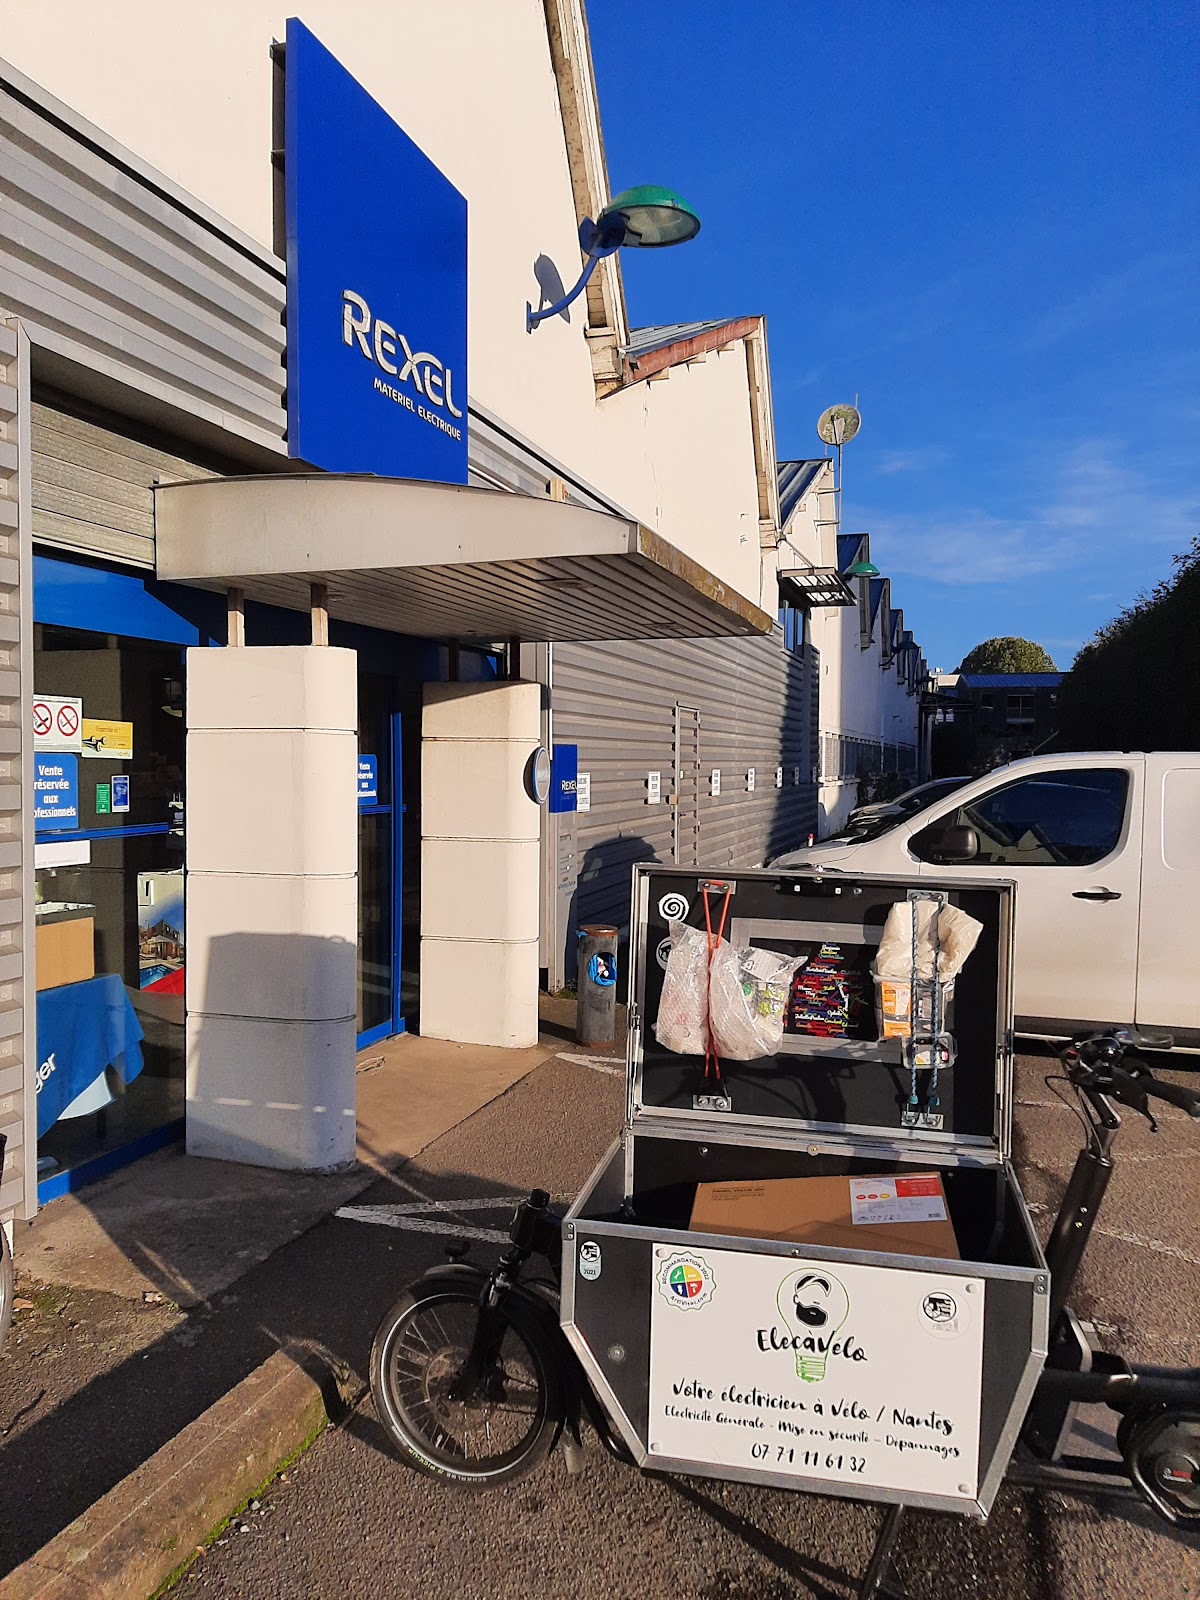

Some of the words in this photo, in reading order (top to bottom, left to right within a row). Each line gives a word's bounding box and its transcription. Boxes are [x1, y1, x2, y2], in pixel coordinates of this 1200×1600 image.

[343, 289, 463, 418] REXEL
[373, 377, 415, 412] MATERIEL
[418, 405, 461, 441] ELECTRIQUE
[34, 778, 69, 790] réservée
[38, 764, 63, 776] Vente
[43, 795, 59, 804] aux
[583, 1268, 596, 1276] 2021
[662, 1258, 702, 1285] RECOMMANDATION
[700, 1268, 710, 1281] 2022
[757, 1326, 868, 1361] ElecàVélo
[673, 1377, 715, 1400] Votre
[721, 1385, 807, 1411] électricien
[814, 1398, 824, 1416] à
[831, 1398, 870, 1420] Vélo
[876, 1405, 886, 1423] /
[893, 1408, 954, 1436] Nantes
[665, 1405, 711, 1422] Electricité
[716, 1412, 765, 1429] Générale
[778, 1420, 805, 1437] Mise
[810, 1428, 824, 1436] en
[828, 1429, 869, 1443] sécurité
[886, 1434, 960, 1460] Dépannages
[751, 1443, 770, 1460] 07
[777, 1446, 794, 1464] 71
[801, 1451, 819, 1467] 11
[825, 1453, 843, 1469] 61
[850, 1456, 866, 1474] 32
